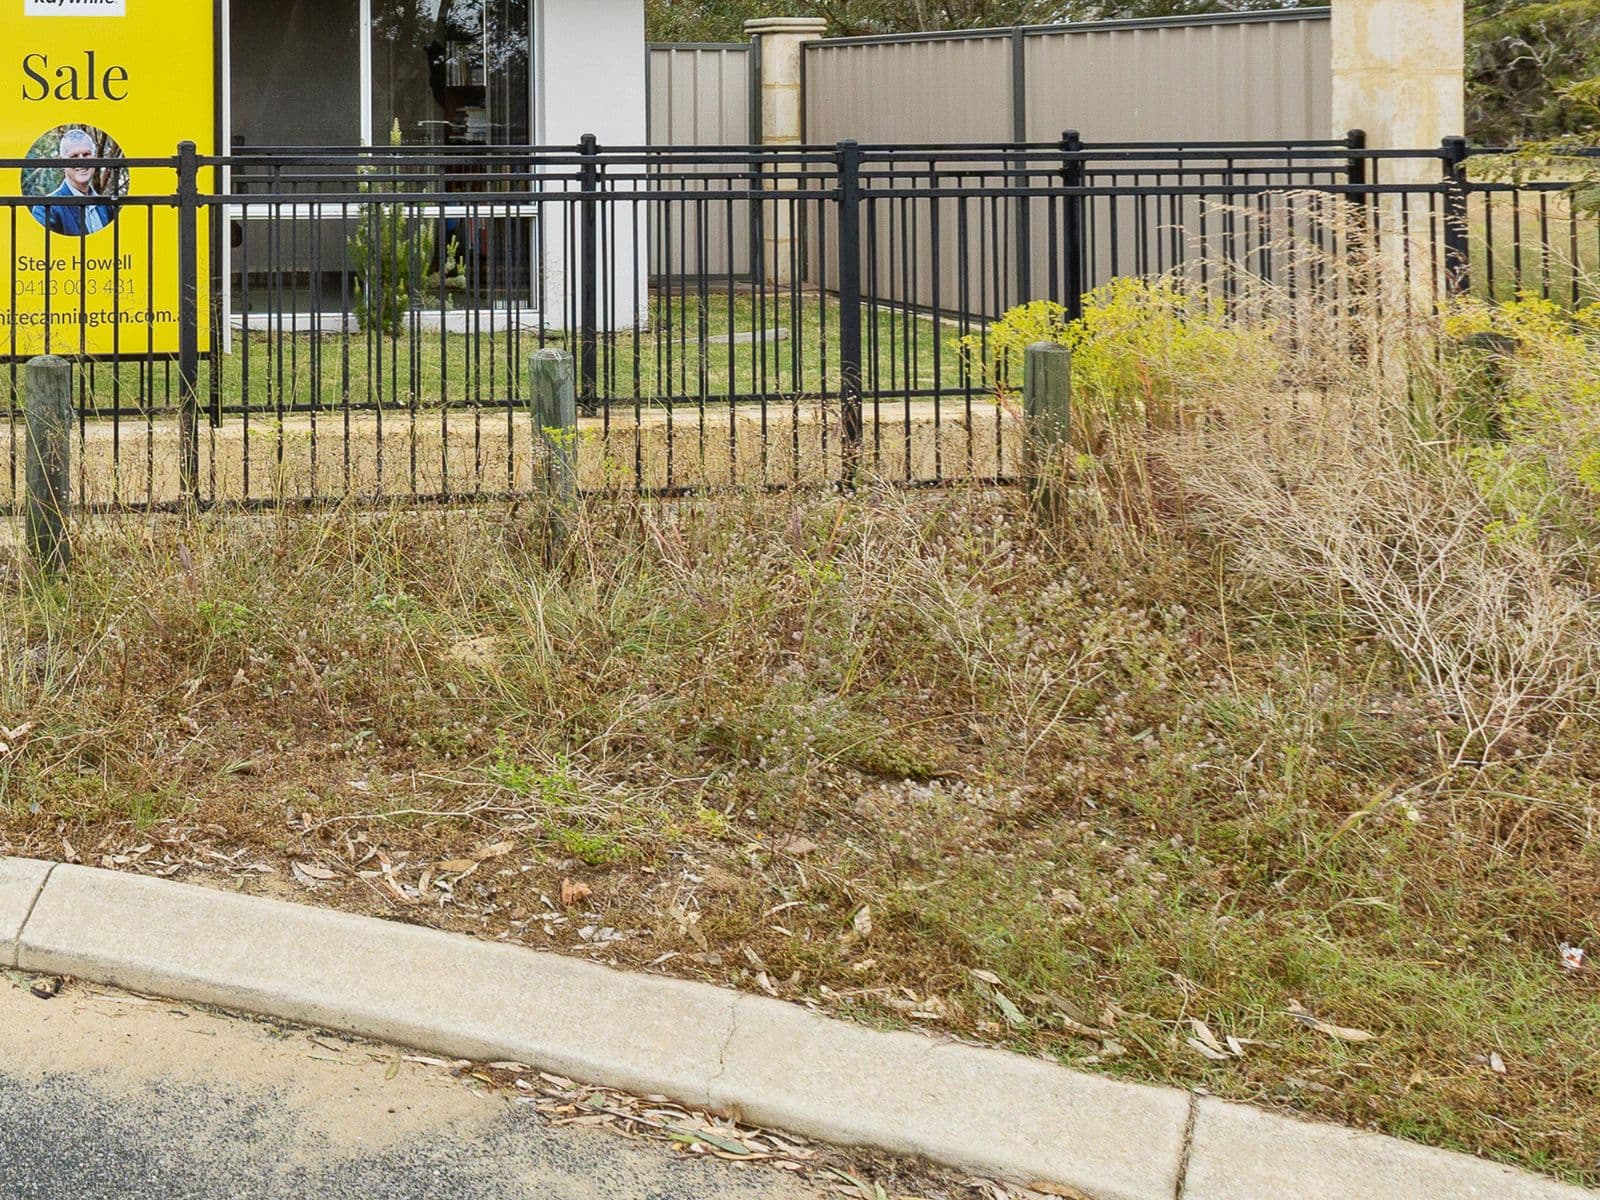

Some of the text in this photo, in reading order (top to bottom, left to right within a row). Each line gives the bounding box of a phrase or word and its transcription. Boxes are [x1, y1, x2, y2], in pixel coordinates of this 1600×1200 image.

[22, 50, 129, 101] Sale
[17, 254, 131, 271] Steve Howell
[15, 279, 58, 296] 0413
